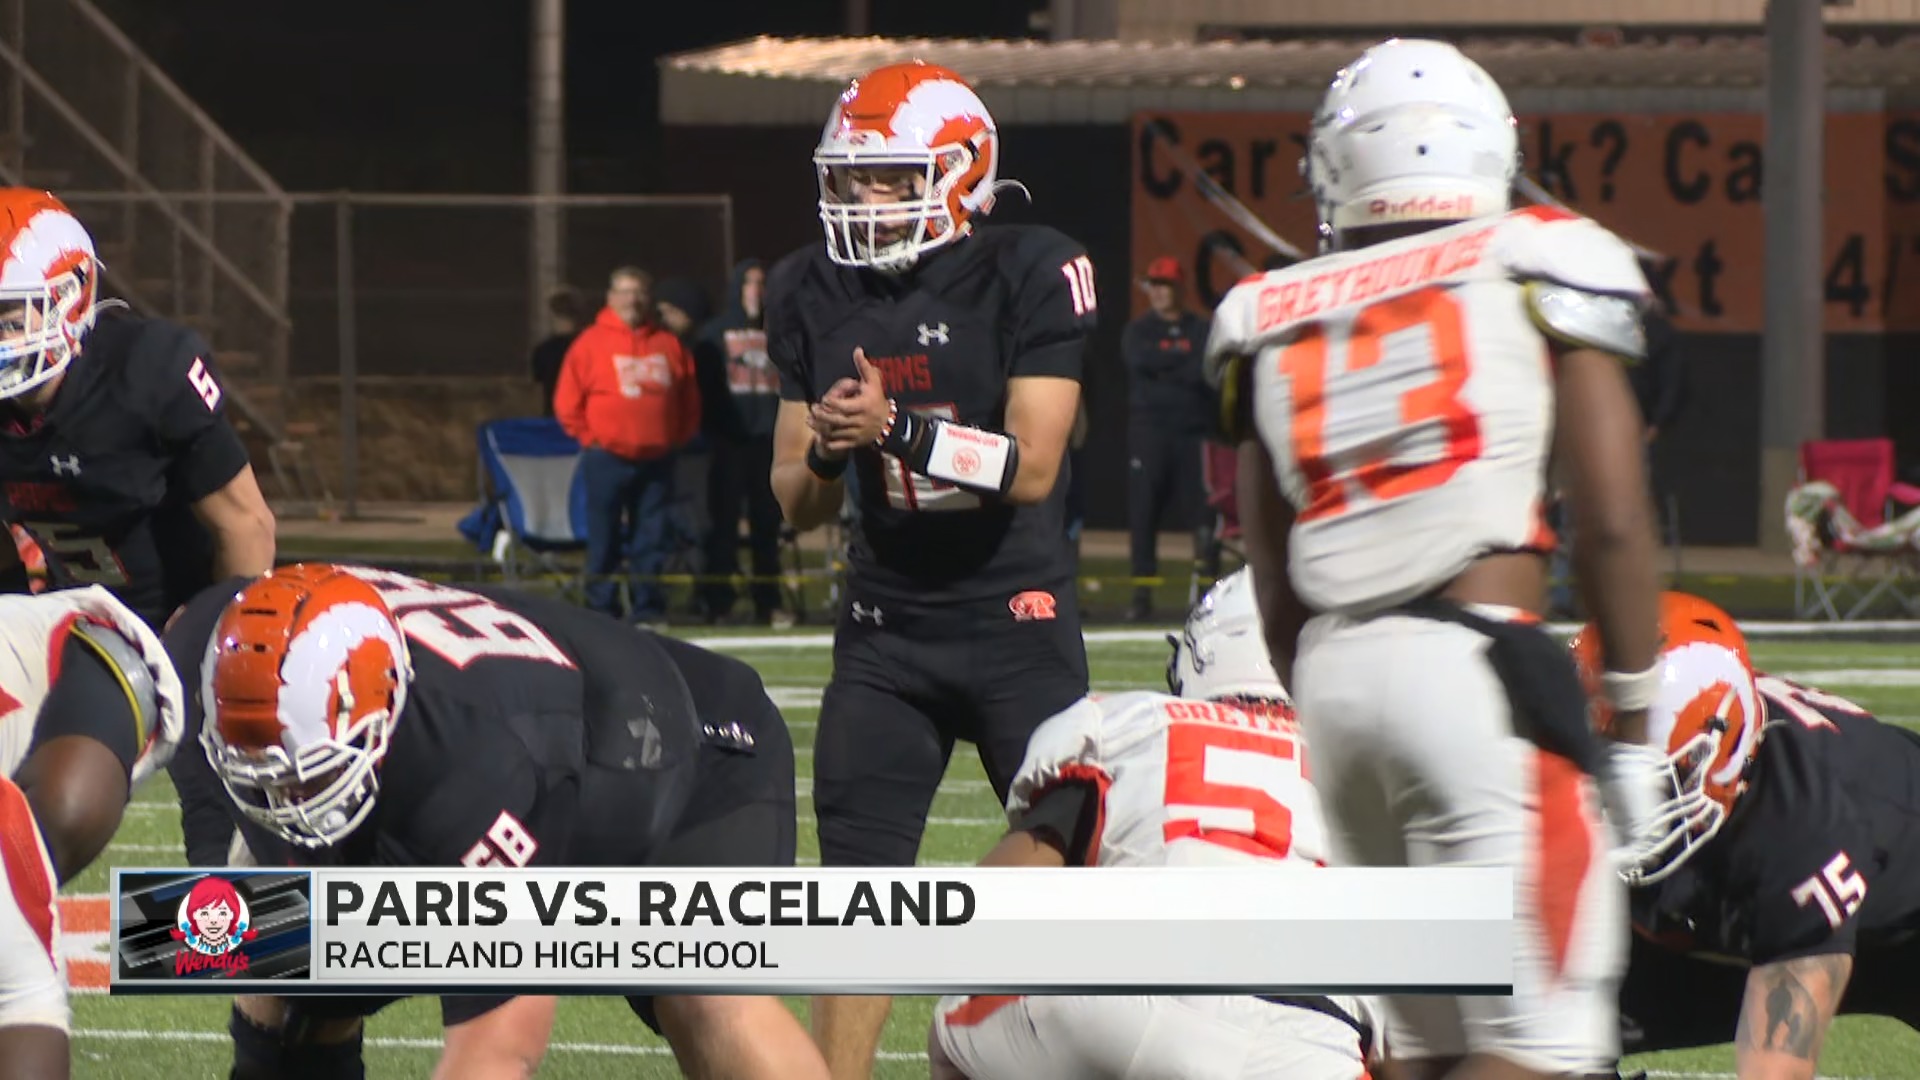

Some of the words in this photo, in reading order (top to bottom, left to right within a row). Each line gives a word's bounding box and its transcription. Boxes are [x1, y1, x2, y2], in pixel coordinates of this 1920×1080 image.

[1141, 118, 1277, 200] Car
[1665, 119, 1764, 204] Ca
[1060, 254, 1098, 317] 10
[187, 356, 222, 414] 5
[868, 353, 933, 393] AMS
[1276, 285, 1483, 524] 13
[1789, 849, 1868, 930] 75
